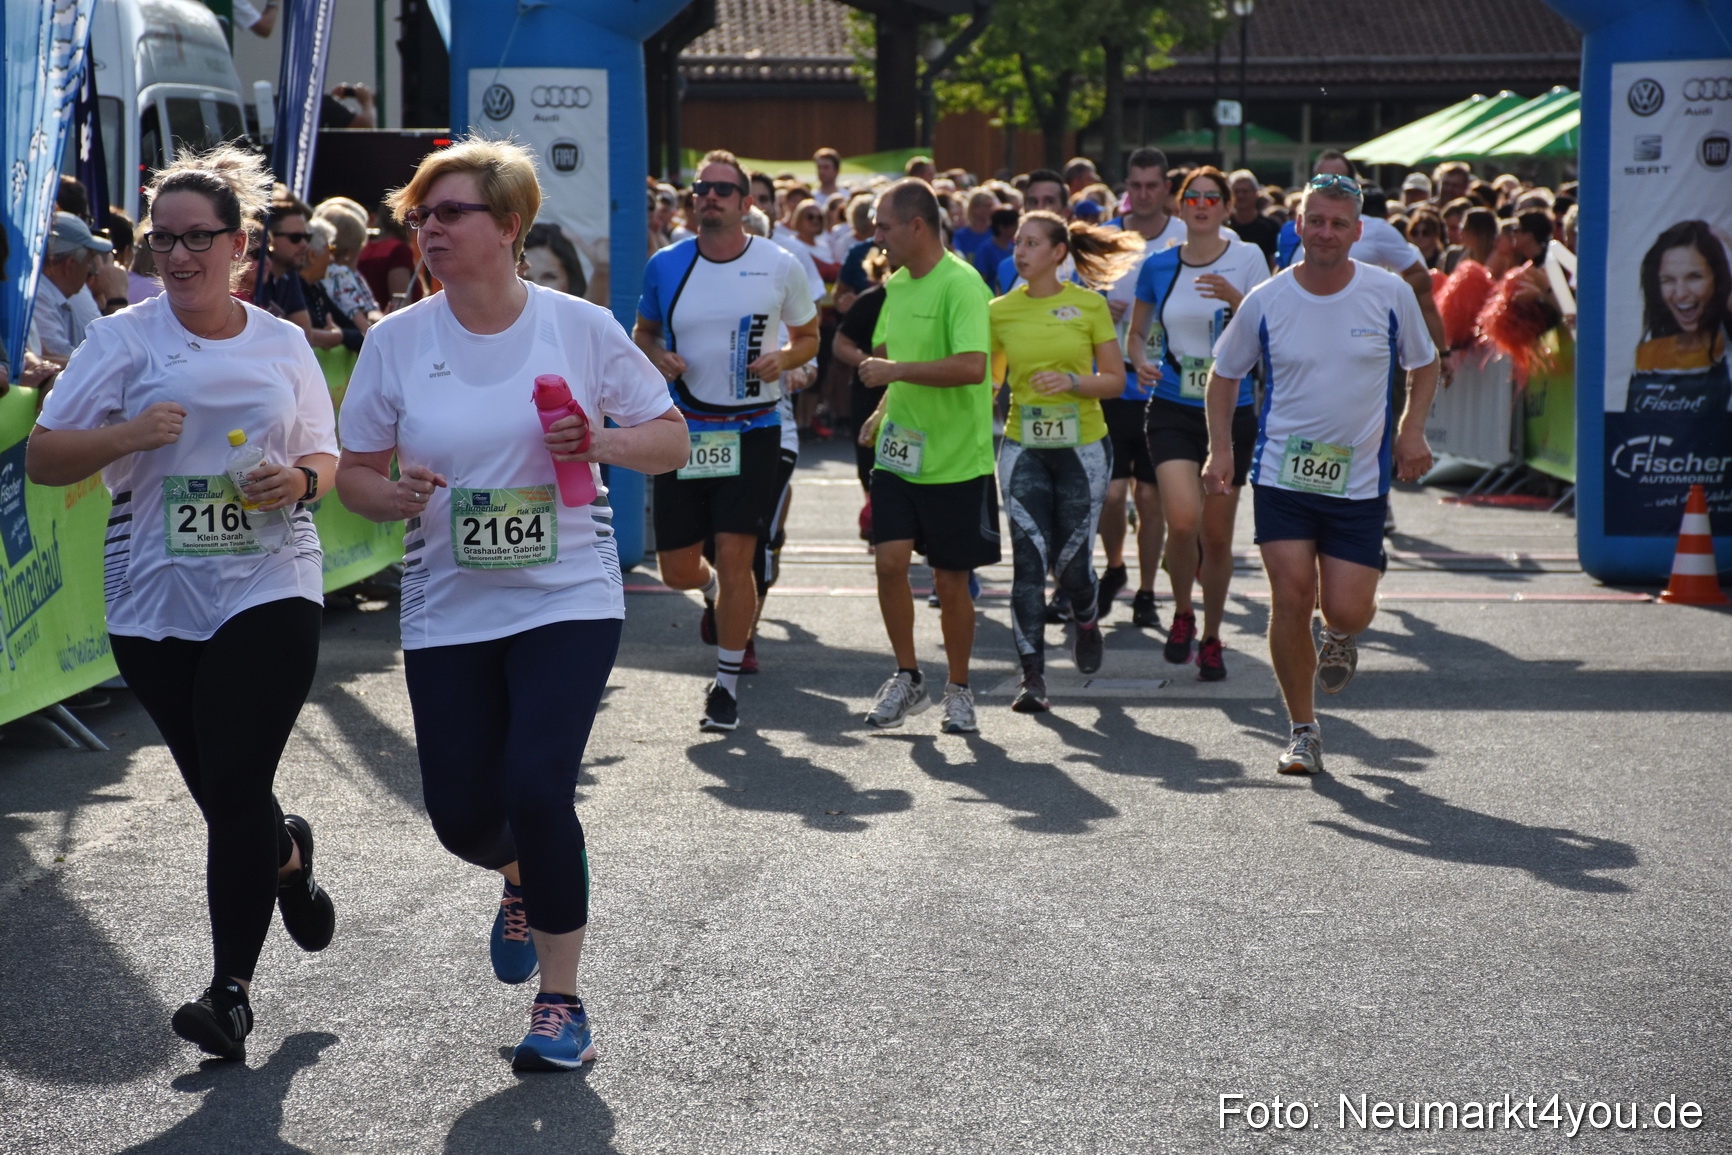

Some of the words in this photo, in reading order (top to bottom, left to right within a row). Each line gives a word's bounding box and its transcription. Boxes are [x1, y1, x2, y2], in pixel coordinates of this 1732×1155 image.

[1684, 107, 1713, 116] Audi
[533, 114, 559, 122] Audi
[1705, 142, 1729, 161] FIAT
[554, 148, 577, 166] FIAT
[1624, 166, 1672, 175] SEAT
[164, 359, 188, 368] erima
[429, 370, 451, 379] erima
[1032, 421, 1065, 437] 671
[882, 438, 909, 461] 664
[689, 447, 731, 465] 1058
[1630, 452, 1732, 473] Fischer
[1291, 456, 1341, 480] 1840
[1639, 474, 1724, 484] AUTOMOBILE
[180, 489, 225, 500] firmenlauf
[465, 503, 508, 513] firmenlauf
[531, 506, 550, 515] 2019
[462, 514, 545, 546] 2164
[197, 533, 219, 541] Klein
[221, 533, 243, 541] Sarah
[463, 546, 511, 555] Grashaußer
[513, 545, 546, 553] Gabriele
